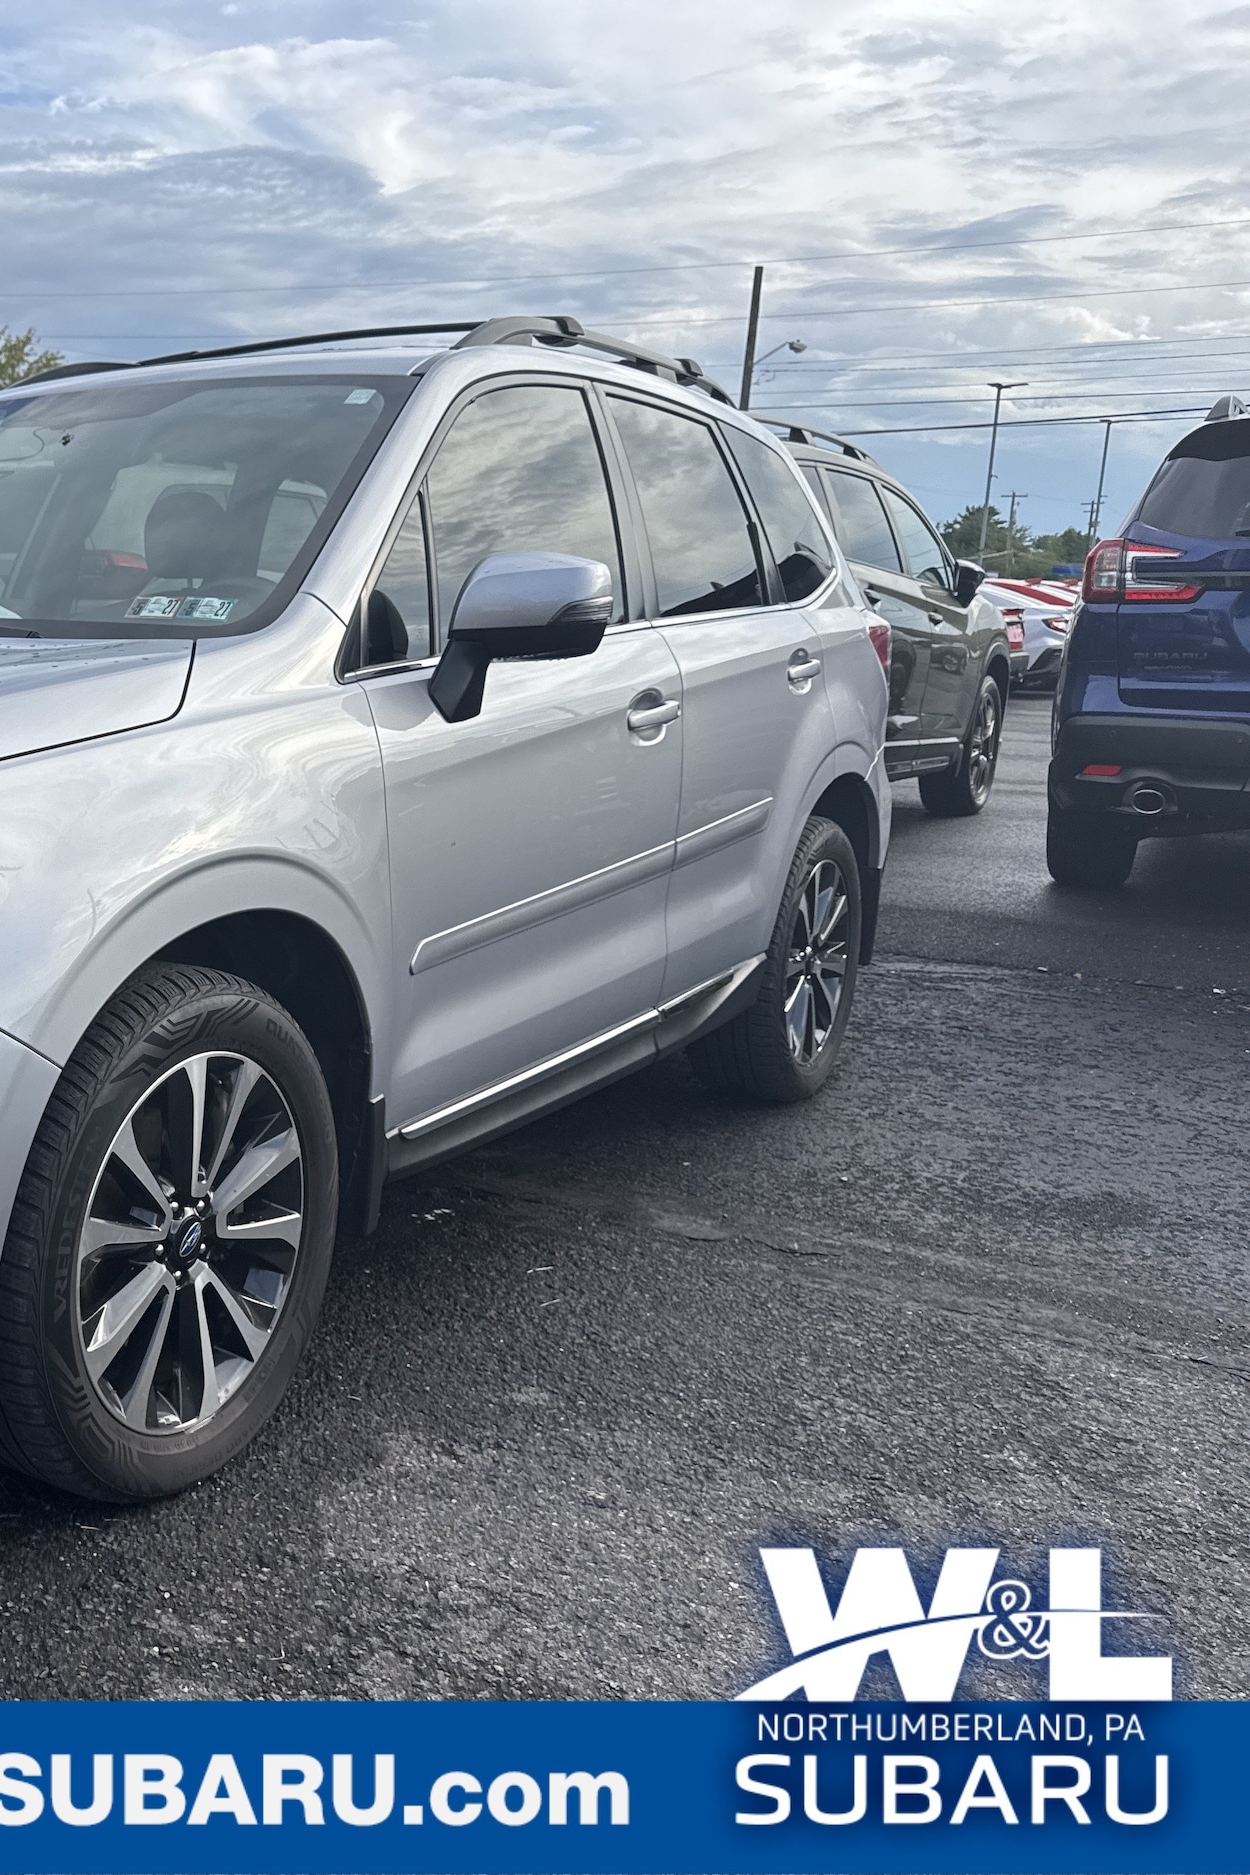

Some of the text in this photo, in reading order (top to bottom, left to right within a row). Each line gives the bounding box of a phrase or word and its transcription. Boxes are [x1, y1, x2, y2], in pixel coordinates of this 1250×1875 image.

[161, 599, 179, 615] 27
[214, 601, 232, 617] 27
[1133, 651, 1208, 660] SUBARU
